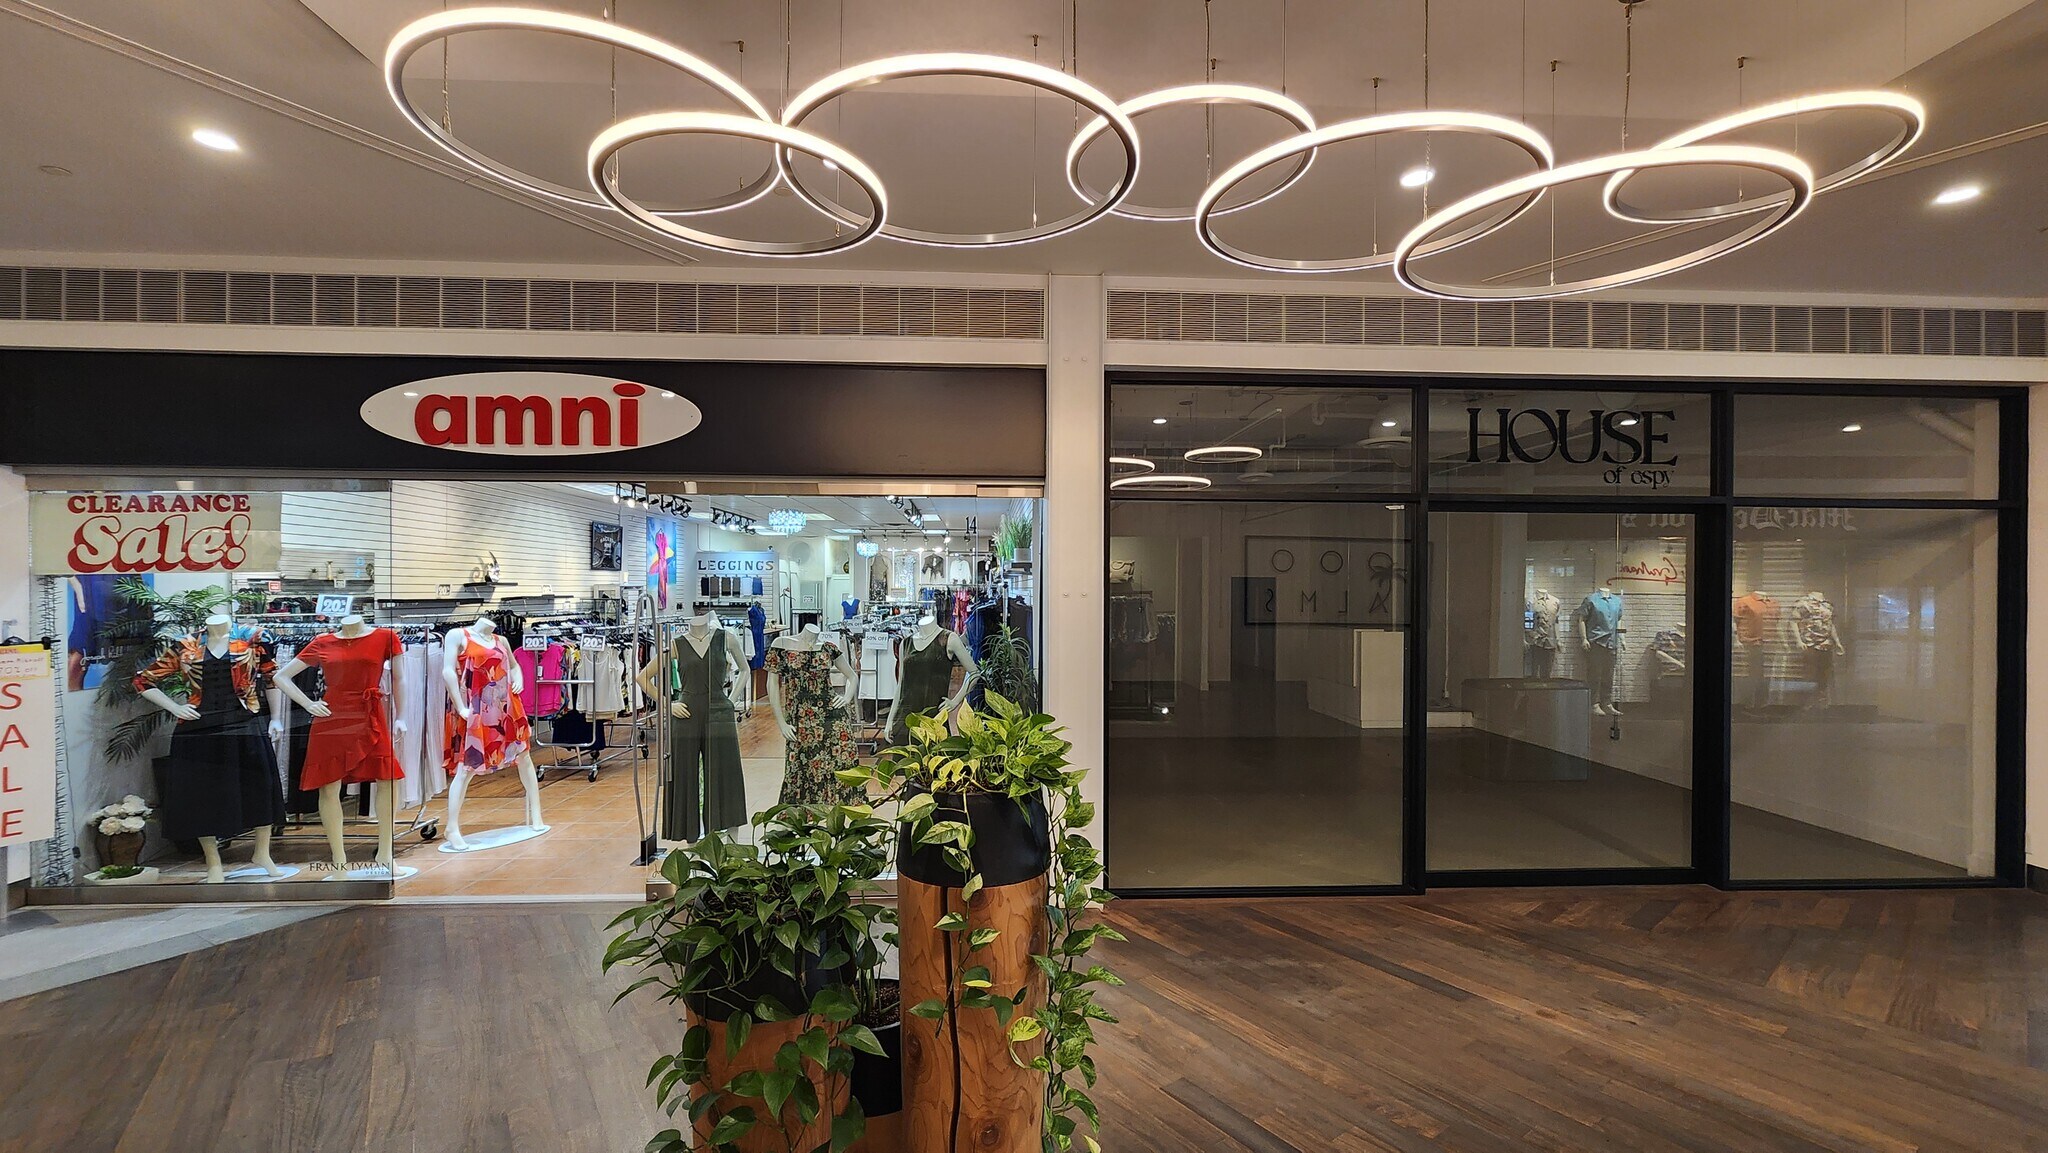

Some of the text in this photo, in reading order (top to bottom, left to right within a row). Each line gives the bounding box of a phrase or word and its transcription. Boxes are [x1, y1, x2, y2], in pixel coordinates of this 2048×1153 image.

[414, 382, 646, 446] amni
[1466, 408, 1678, 466] HOUSE
[1603, 466, 1626, 484] of
[67, 494, 250, 514] CLEARANCE
[965, 516, 977, 534] 14
[67, 514, 251, 573] Sale!
[697, 560, 774, 571] LEGGINGS
[0, 682, 29, 838] SALE
[309, 862, 390, 872] FRANK LYMAN
